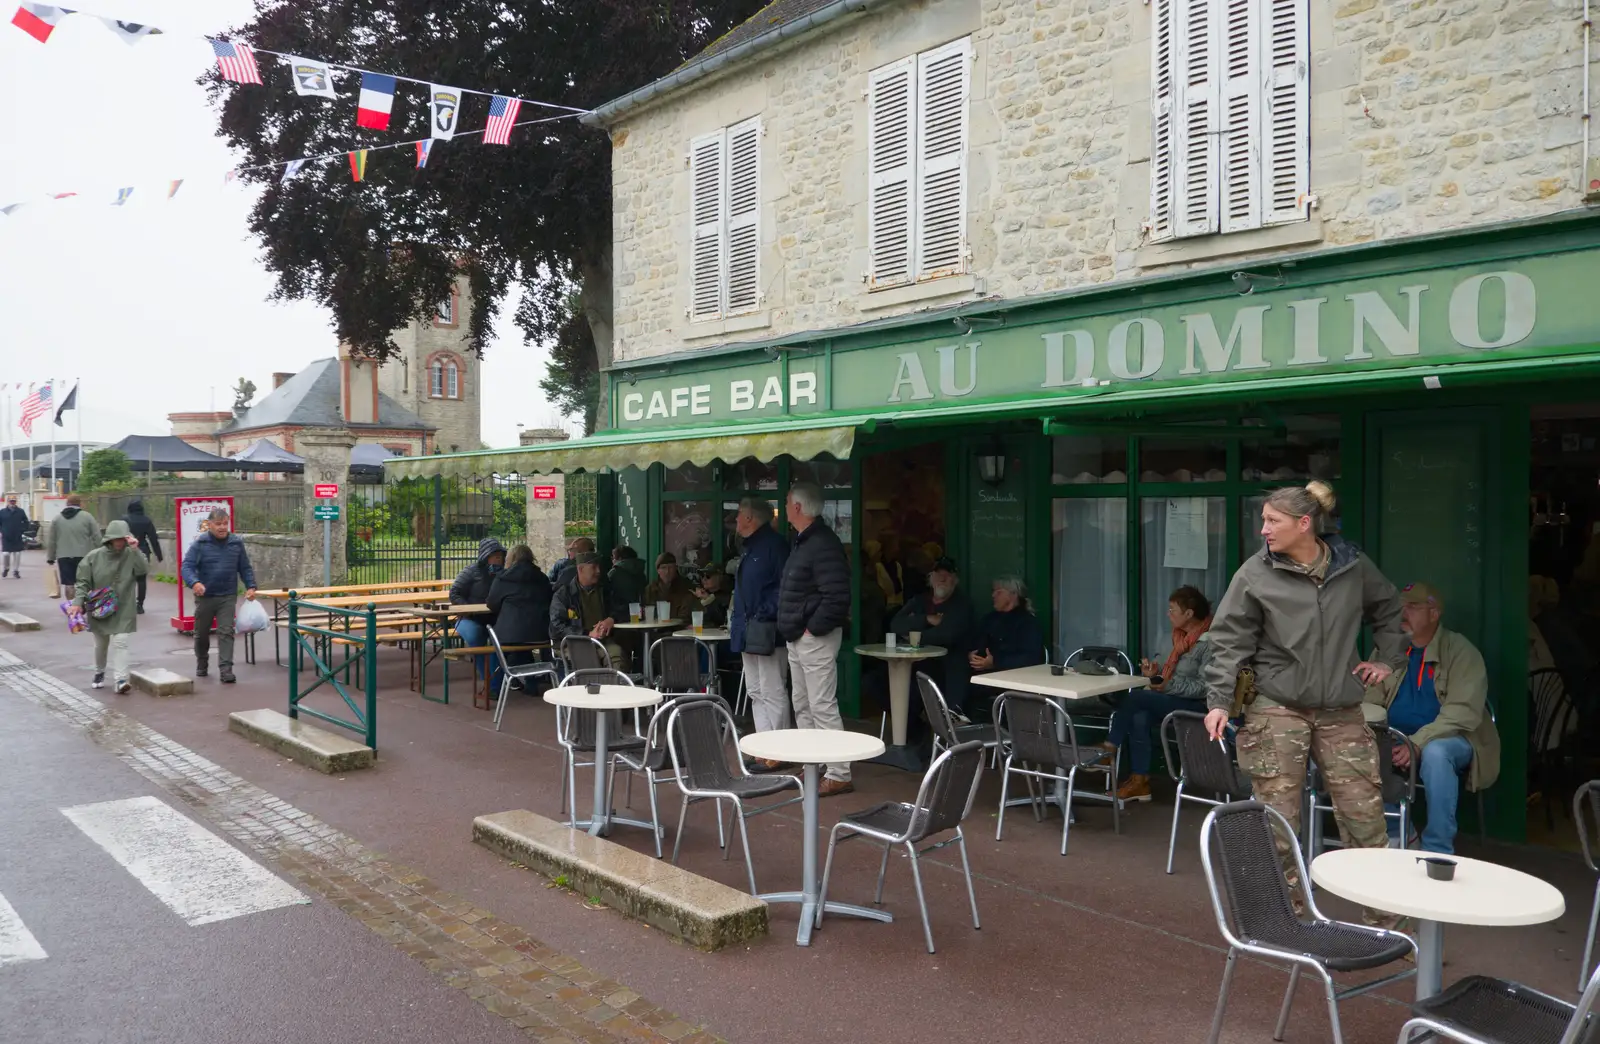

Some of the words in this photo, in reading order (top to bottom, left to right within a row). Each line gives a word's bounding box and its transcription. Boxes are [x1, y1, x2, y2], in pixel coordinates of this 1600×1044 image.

[886, 340, 983, 403] AU
[1041, 269, 1537, 389] DOMINO
[623, 383, 711, 421] CAFE
[729, 371, 817, 412] BAR
[319, 470, 333, 481] 10
[182, 505, 227, 516] PIZZER
[618, 473, 641, 538] CARTES
